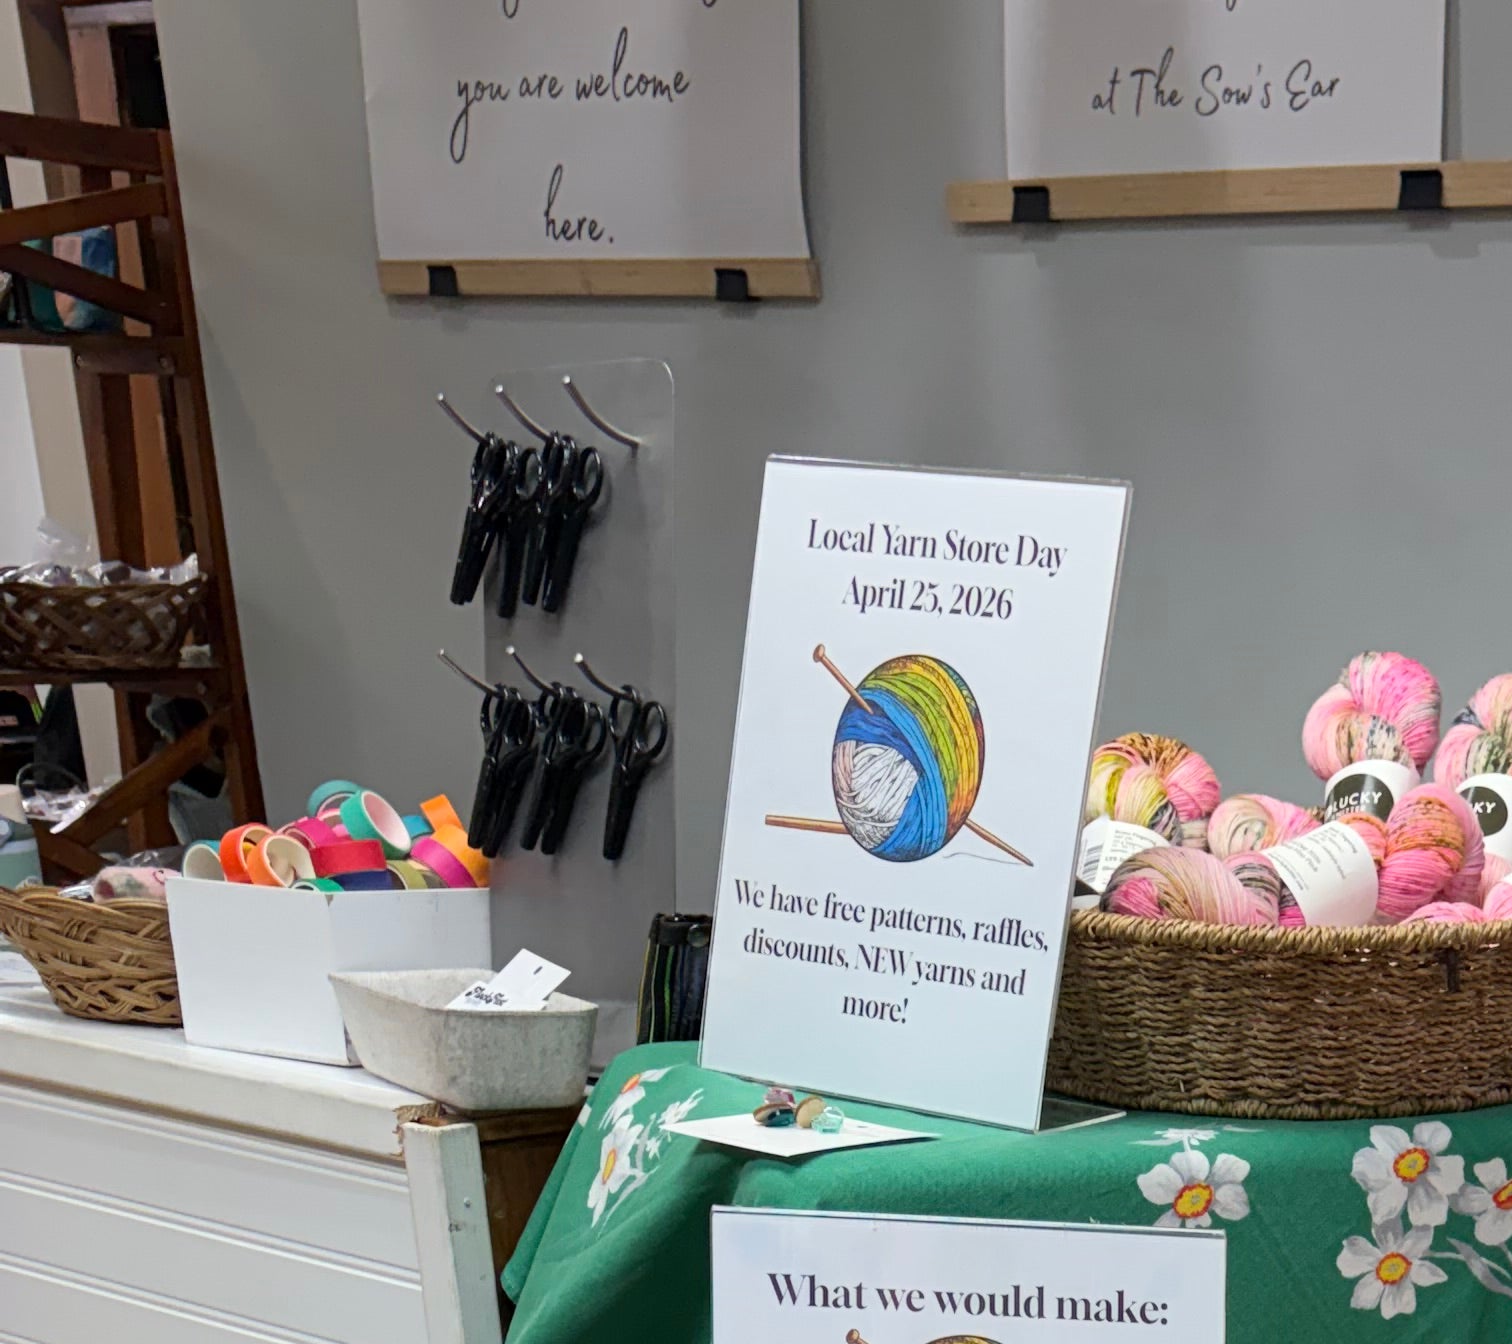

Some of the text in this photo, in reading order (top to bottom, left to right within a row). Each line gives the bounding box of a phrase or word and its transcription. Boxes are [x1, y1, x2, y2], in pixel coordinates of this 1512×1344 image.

[450, 27, 689, 164] you are welcome
[1092, 46, 1339, 116] at The Sow's Ear
[544, 164, 613, 243] here.
[808, 519, 1067, 577] Local Yarn Store Day
[841, 575, 1012, 619] April 25, 2026
[736, 880, 1048, 952] We have free patterns, raffles,
[744, 928, 1026, 995] discounts, NEW yarns and
[843, 997, 908, 1023] more!
[768, 1273, 1167, 1325] What we would make:
